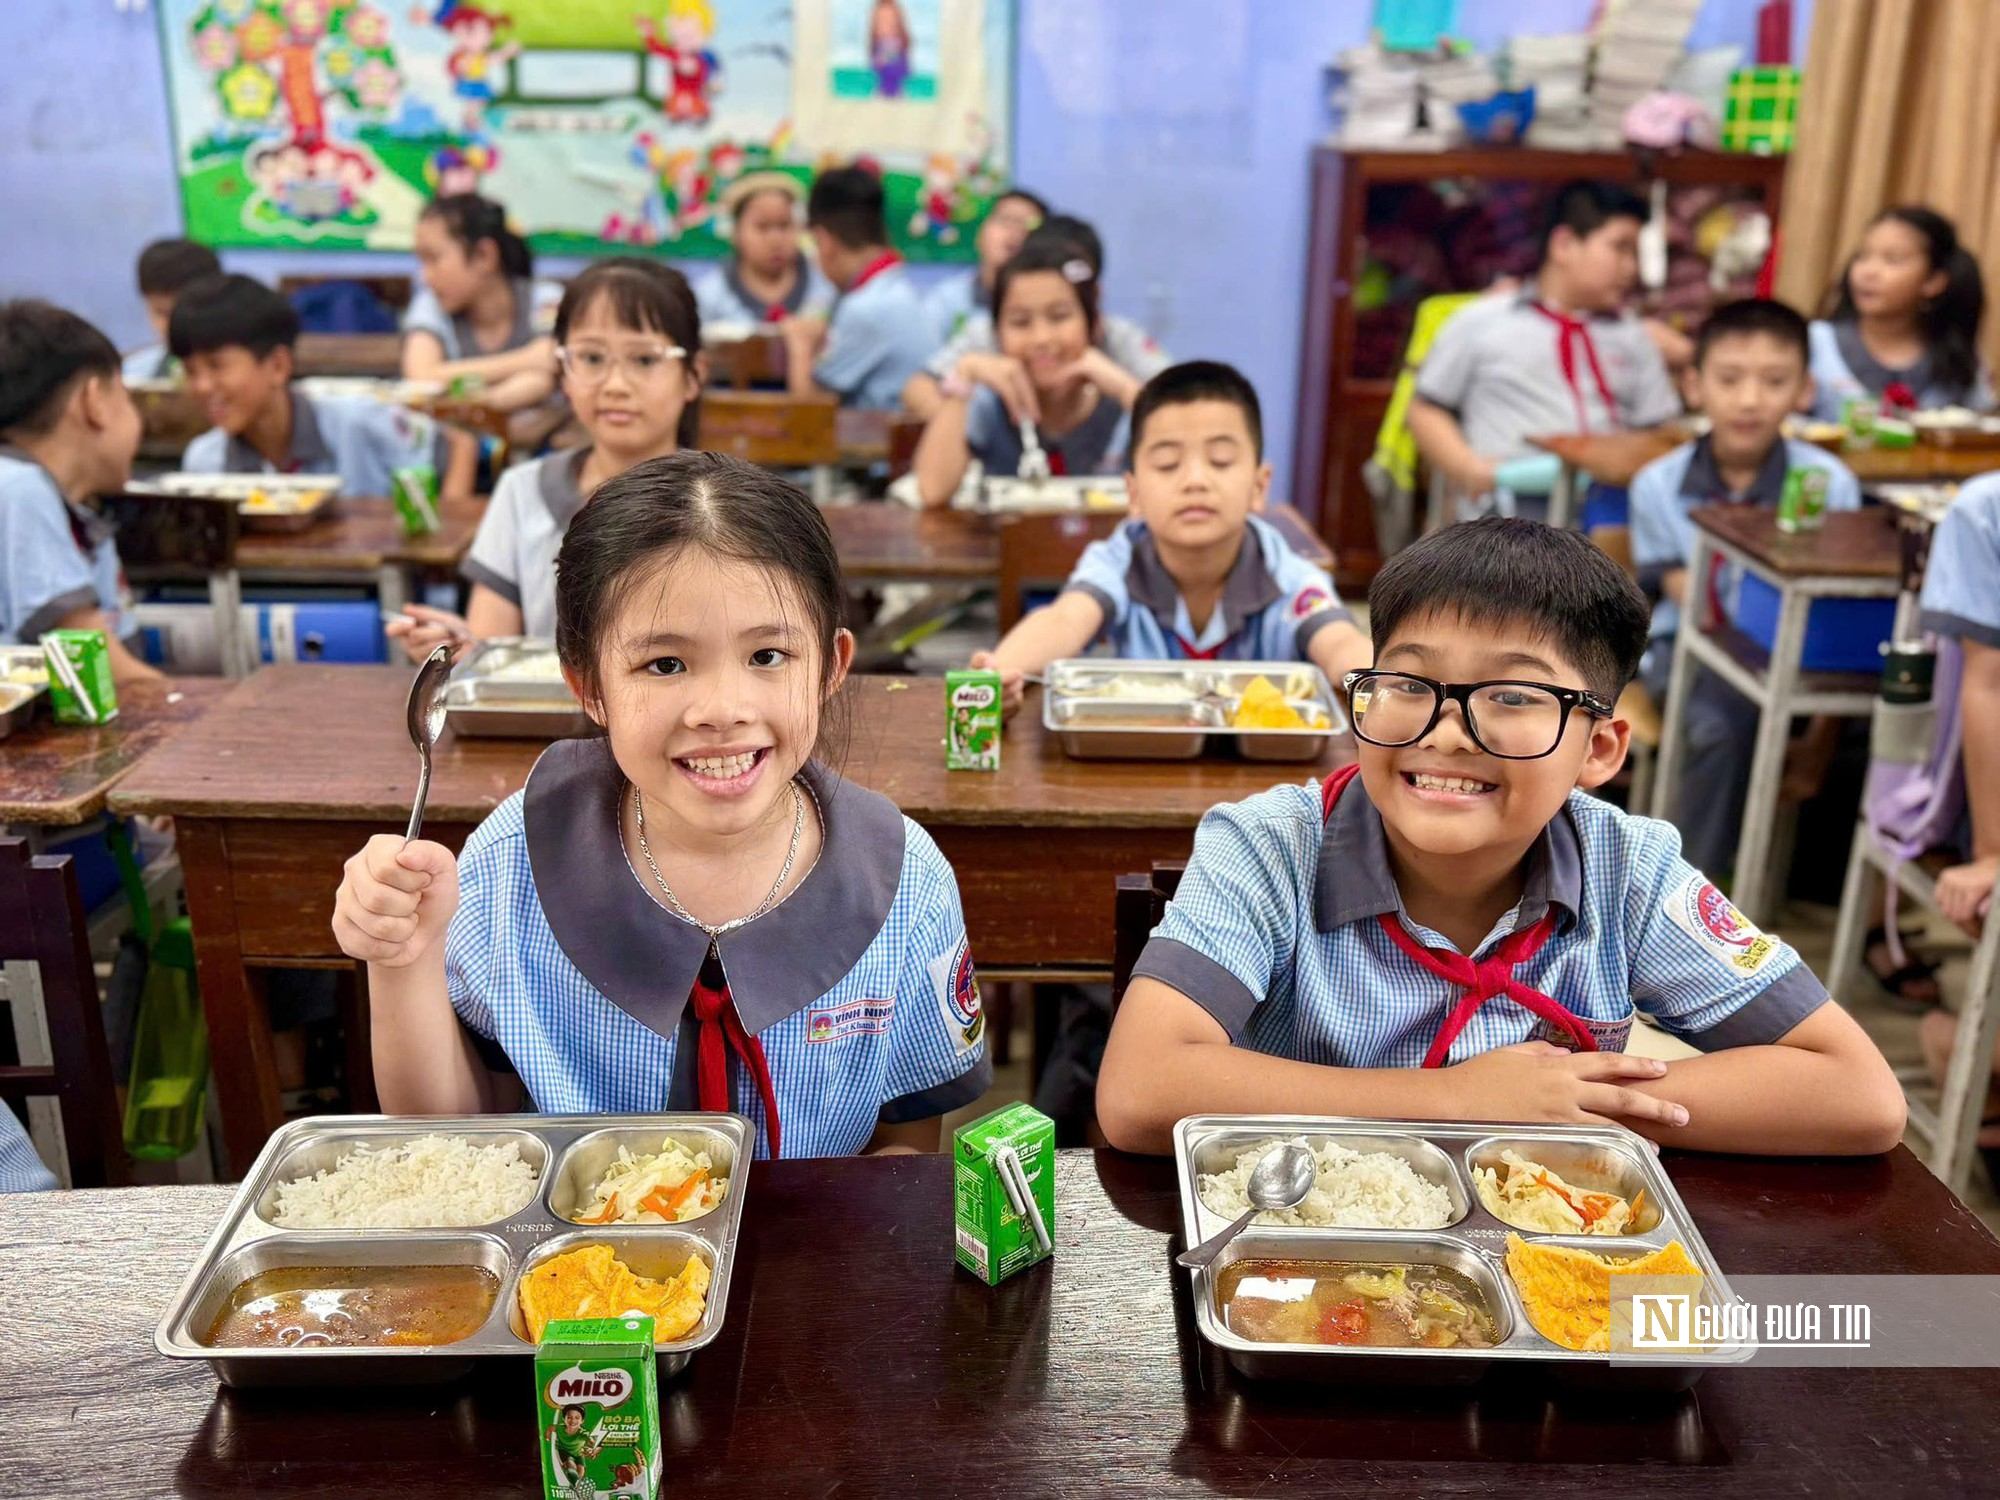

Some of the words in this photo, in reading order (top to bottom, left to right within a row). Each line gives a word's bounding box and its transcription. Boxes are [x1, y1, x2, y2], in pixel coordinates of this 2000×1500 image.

[864, 1006, 893, 1017] NINH
[557, 1379, 624, 1397] MILO
[624, 1415, 641, 1423] BA
[620, 1421, 641, 1430] THẾ
[551, 1489, 564, 1498] 110
